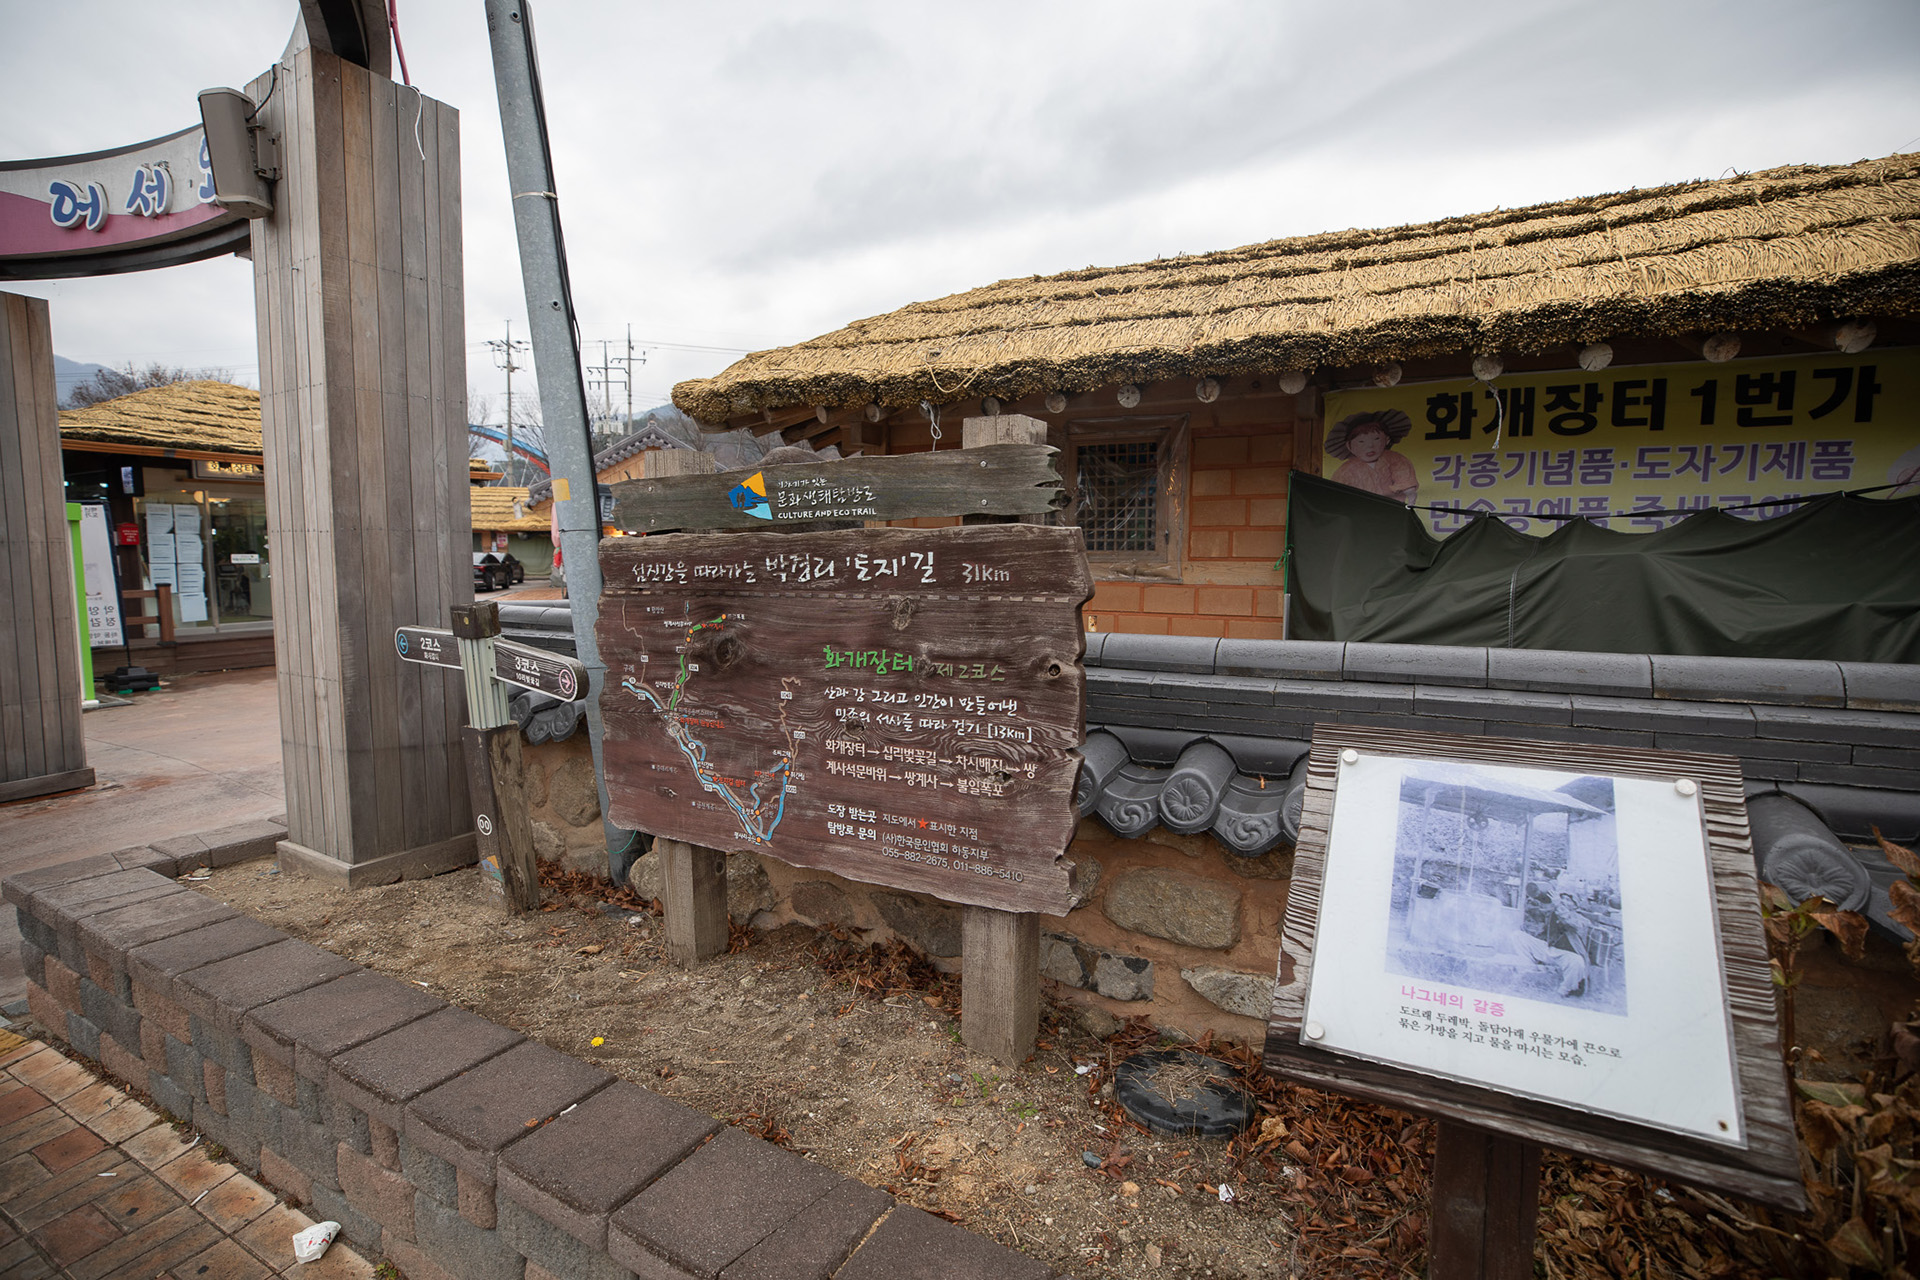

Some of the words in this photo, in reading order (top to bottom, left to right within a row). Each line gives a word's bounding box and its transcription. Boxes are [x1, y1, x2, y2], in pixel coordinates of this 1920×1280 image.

[1424, 378, 1667, 440] 화개장터
[1690, 365, 1882, 428] 1번가
[777, 485, 877, 508] 문화생태탐방로
[777, 510, 813, 519] CULTURE
[814, 510, 832, 518] AND
[833, 509, 850, 517] ECO
[851, 507, 878, 516] TRAIL
[632, 561, 688, 584] 섬진강을
[694, 560, 757, 583] 따라가는
[765, 553, 835, 583] 박경리
[962, 562, 1010, 583] 31km
[420, 636, 441, 652] 2코스
[514, 656, 541, 677] 3코스
[823, 645, 913, 675] 화개장터
[824, 686, 849, 700] 산과
[852, 687, 866, 702] 강
[871, 689, 909, 704] 그리고
[914, 692, 954, 709] 인간이
[958, 695, 1017, 717] 만들어낸
[876, 712, 914, 732] 서사를
[919, 718, 948, 730] 따라
[952, 718, 980, 736] 걷기
[825, 739, 866, 758] 화개장터
[882, 745, 937, 767] 십리벚꽃길
[955, 754, 1004, 773] 차시배지
[826, 760, 888, 782] 계사석문바위
[904, 770, 939, 789] 쌍계사
[956, 778, 1004, 797] 불일폭포
[827, 803, 846, 817] 도장
[848, 806, 877, 824] 받는곳
[882, 813, 917, 829] 지도에서
[929, 820, 957, 838] 표시한
[960, 826, 979, 841] 지점
[827, 821, 855, 837] 탐방로
[857, 826, 877, 841] 문의
[882, 832, 949, 854] (사)한국문인협회
[951, 843, 990, 861] 하동지부
[953, 860, 1025, 882] 011-886-5410
[1401, 984, 1464, 1010] 나그네의
[1473, 998, 1505, 1017] 갈증
[1399, 1005, 1432, 1021] 도르래
[1436, 1012, 1473, 1030] 두레박.
[1478, 1020, 1525, 1040] 돌담아래
[1529, 1031, 1579, 1051] 우물가에
[1583, 1041, 1622, 1059] 끈으로
[1399, 1017, 1421, 1032] 묶은
[1424, 1022, 1458, 1040] 가방을
[1462, 1030, 1485, 1044] 지고
[1489, 1036, 1513, 1051] 물을
[1516, 1042, 1554, 1060] 마시는
[1557, 1050, 1588, 1067] 모습.
